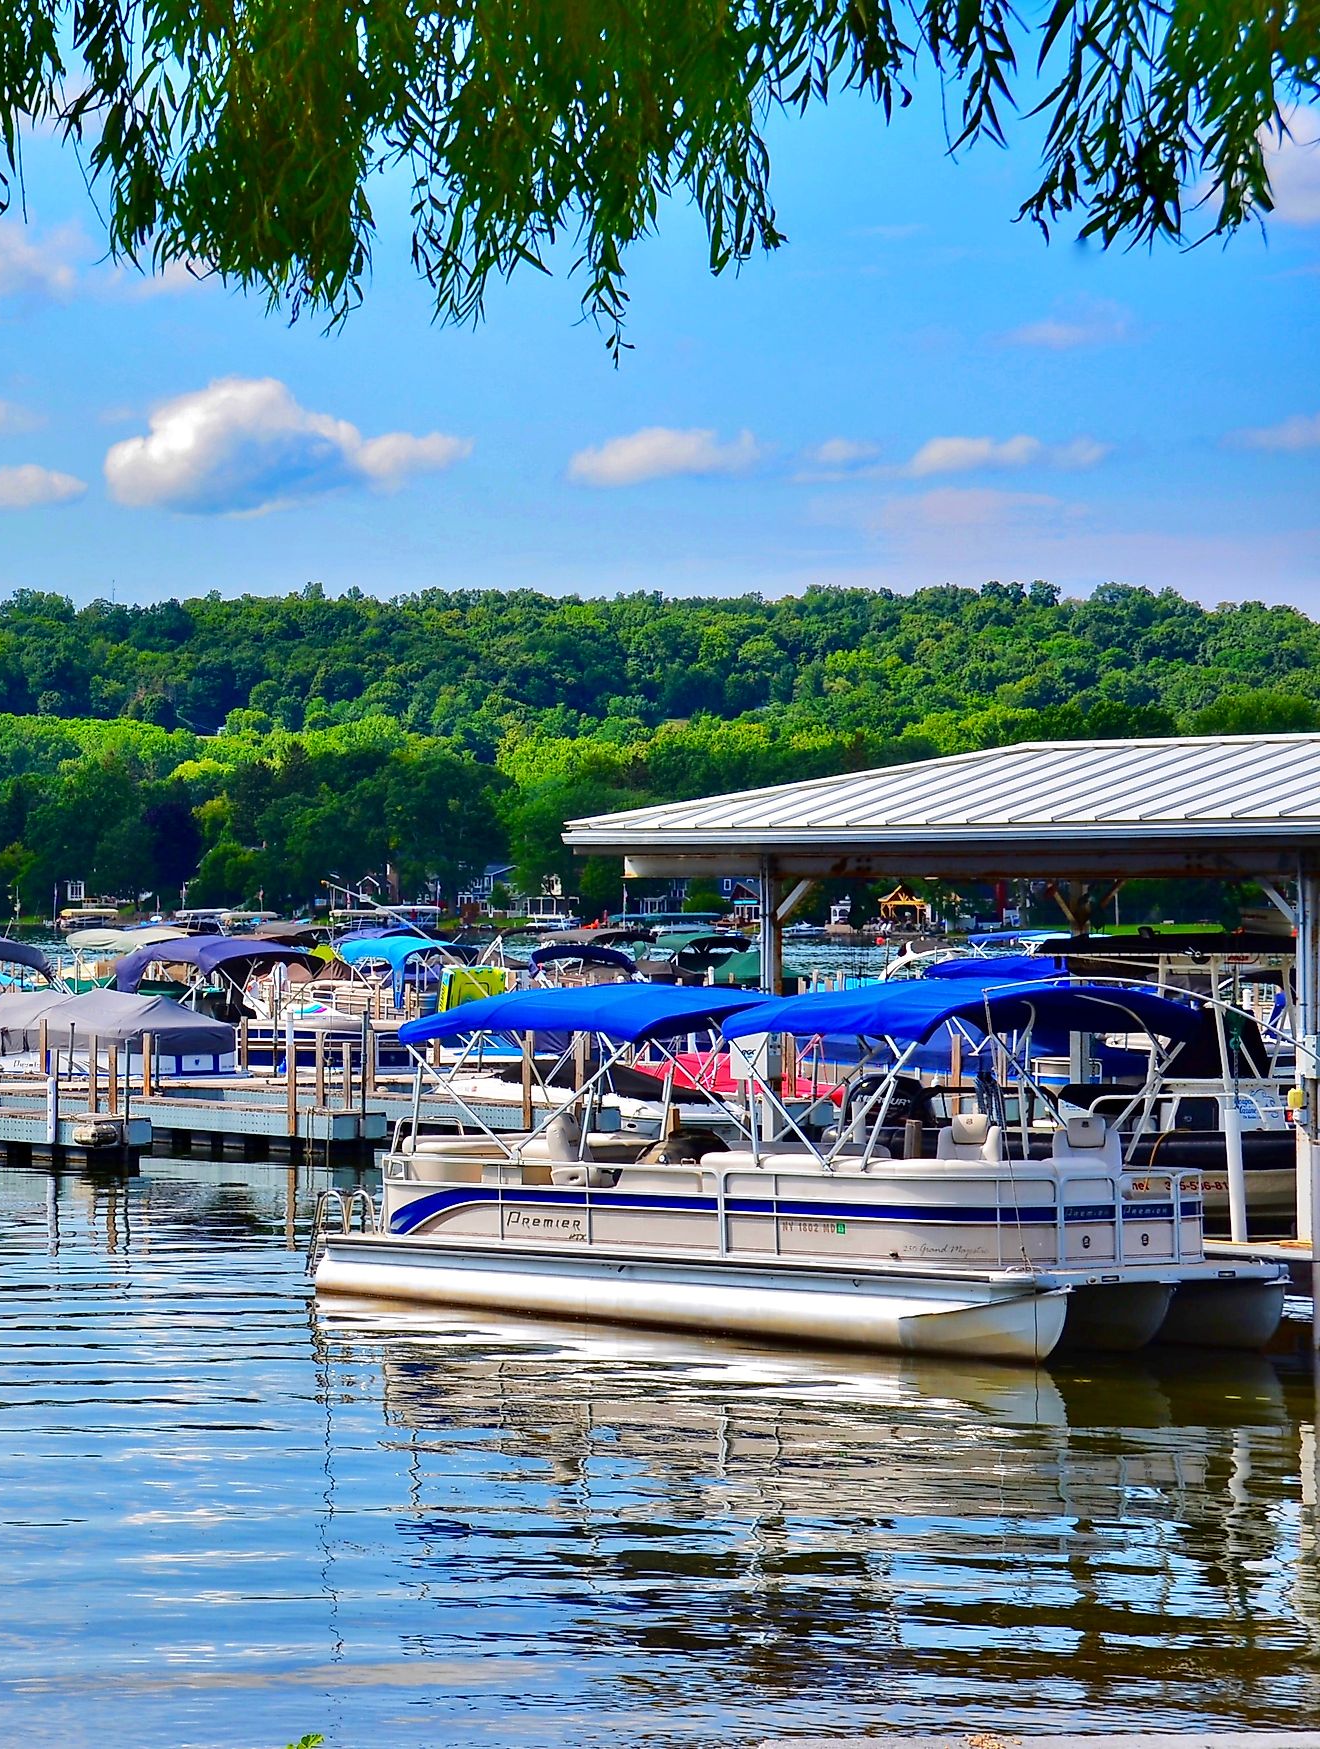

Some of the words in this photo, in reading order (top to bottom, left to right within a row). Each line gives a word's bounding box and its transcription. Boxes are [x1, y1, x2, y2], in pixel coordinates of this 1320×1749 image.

[782, 1221, 794, 1231] NY
[799, 1222, 819, 1233] 1802
[823, 1223, 836, 1233] MD
